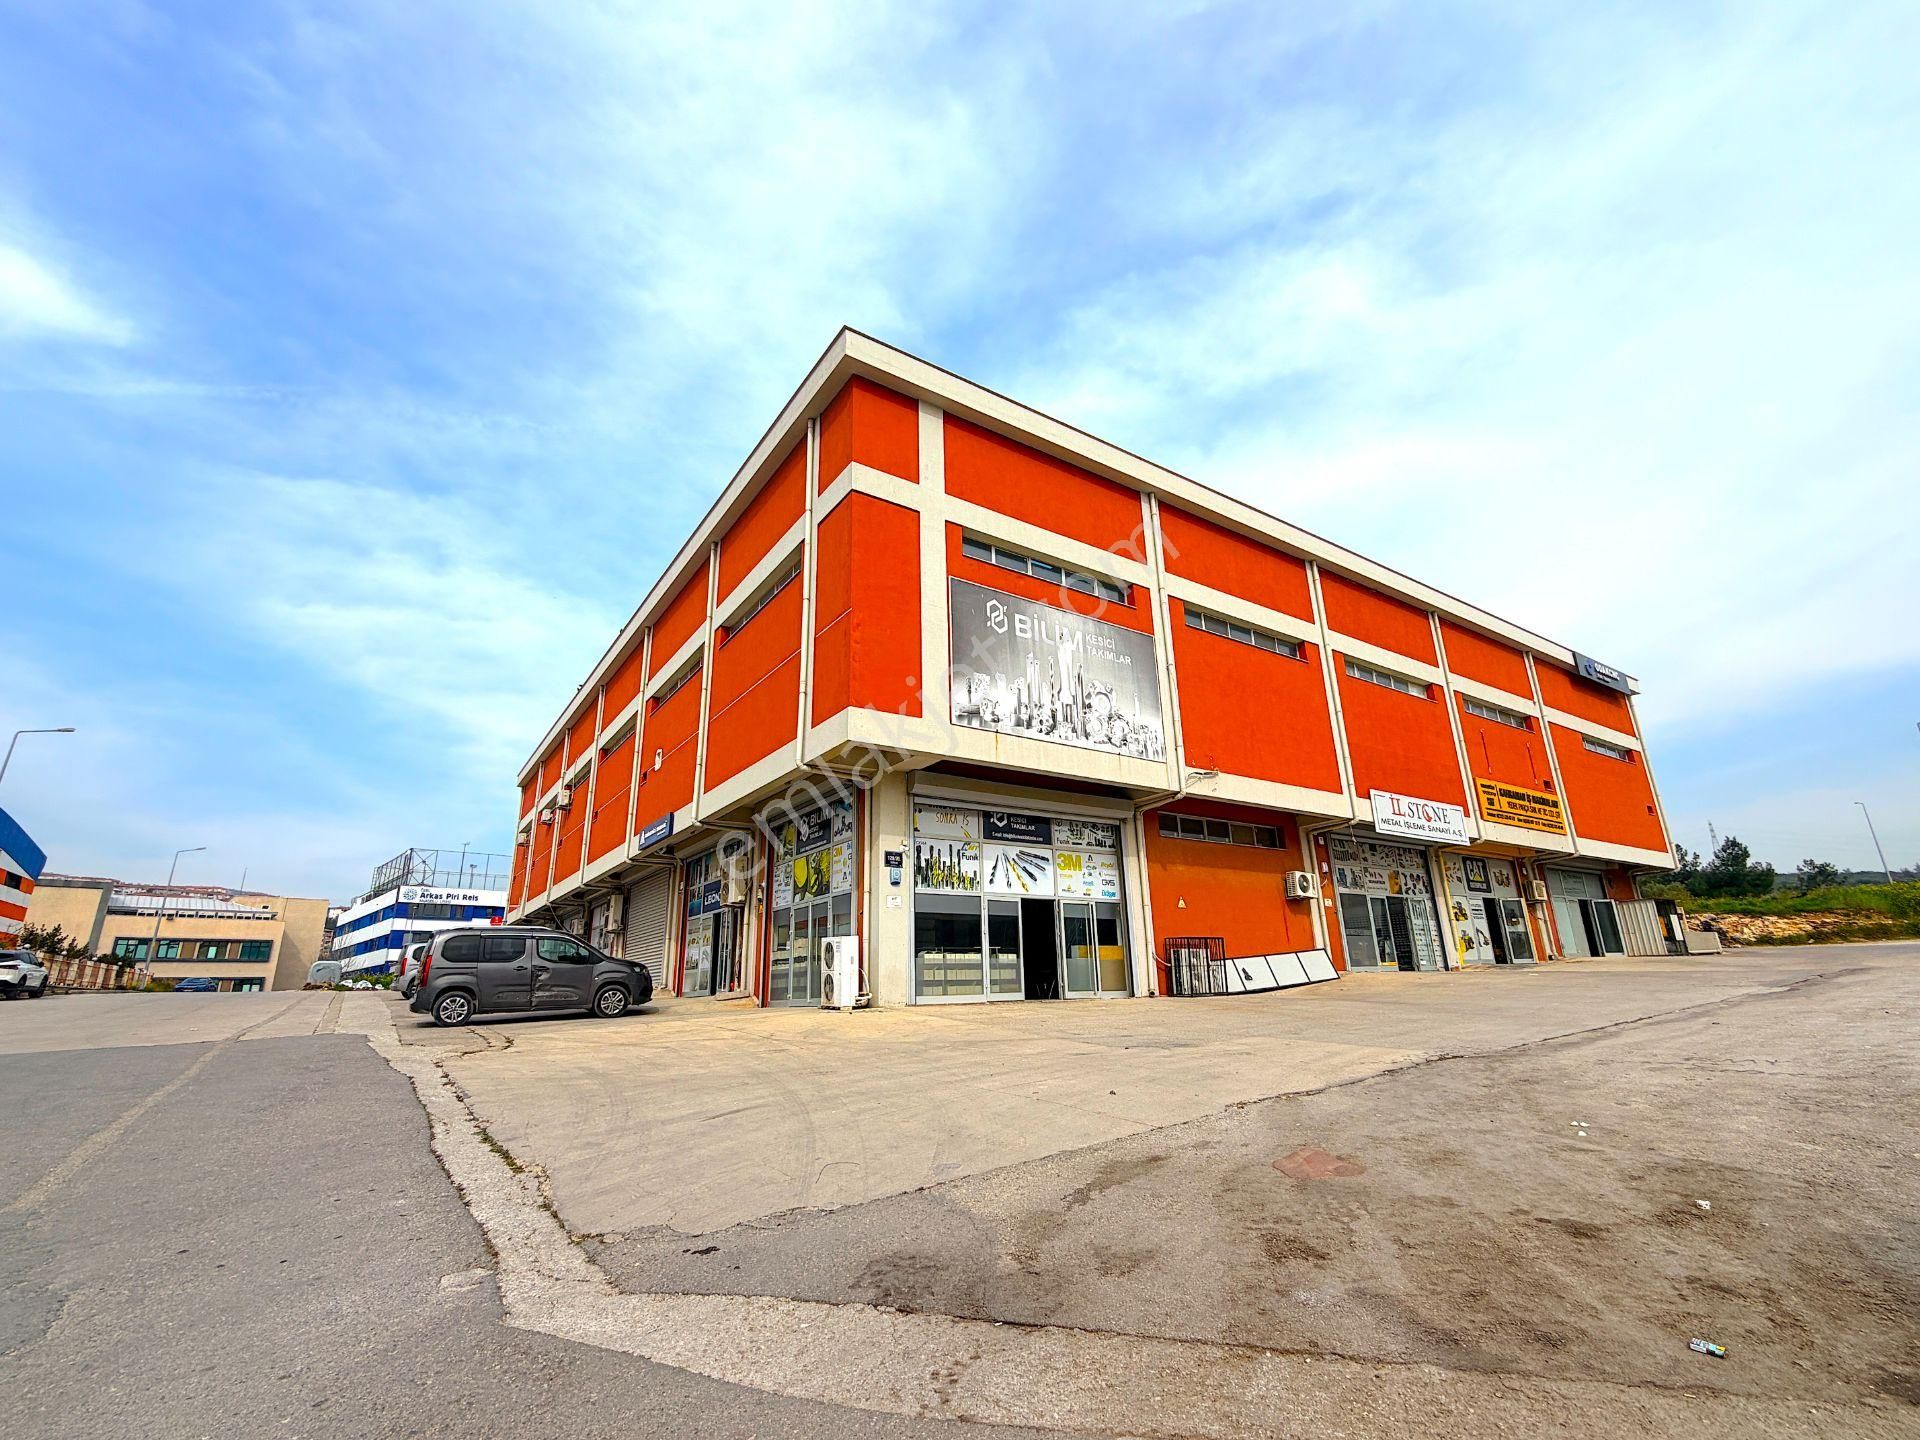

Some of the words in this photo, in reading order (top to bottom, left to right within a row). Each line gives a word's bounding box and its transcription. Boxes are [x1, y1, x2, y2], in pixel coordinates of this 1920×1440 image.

[1085, 632, 1115, 649] KESİCİ
[1086, 646, 1132, 666] TAKIMLAR
[1381, 818, 1403, 828] METAL
[1404, 821, 1427, 831] İŞLEME
[1428, 826, 1451, 836] SANAYİ
[1056, 853, 1083, 872] 3M
[1465, 860, 1485, 881] CAT
[419, 892, 443, 900] Arkas
[446, 893, 460, 901] Piri
[462, 894, 479, 902] Reis
